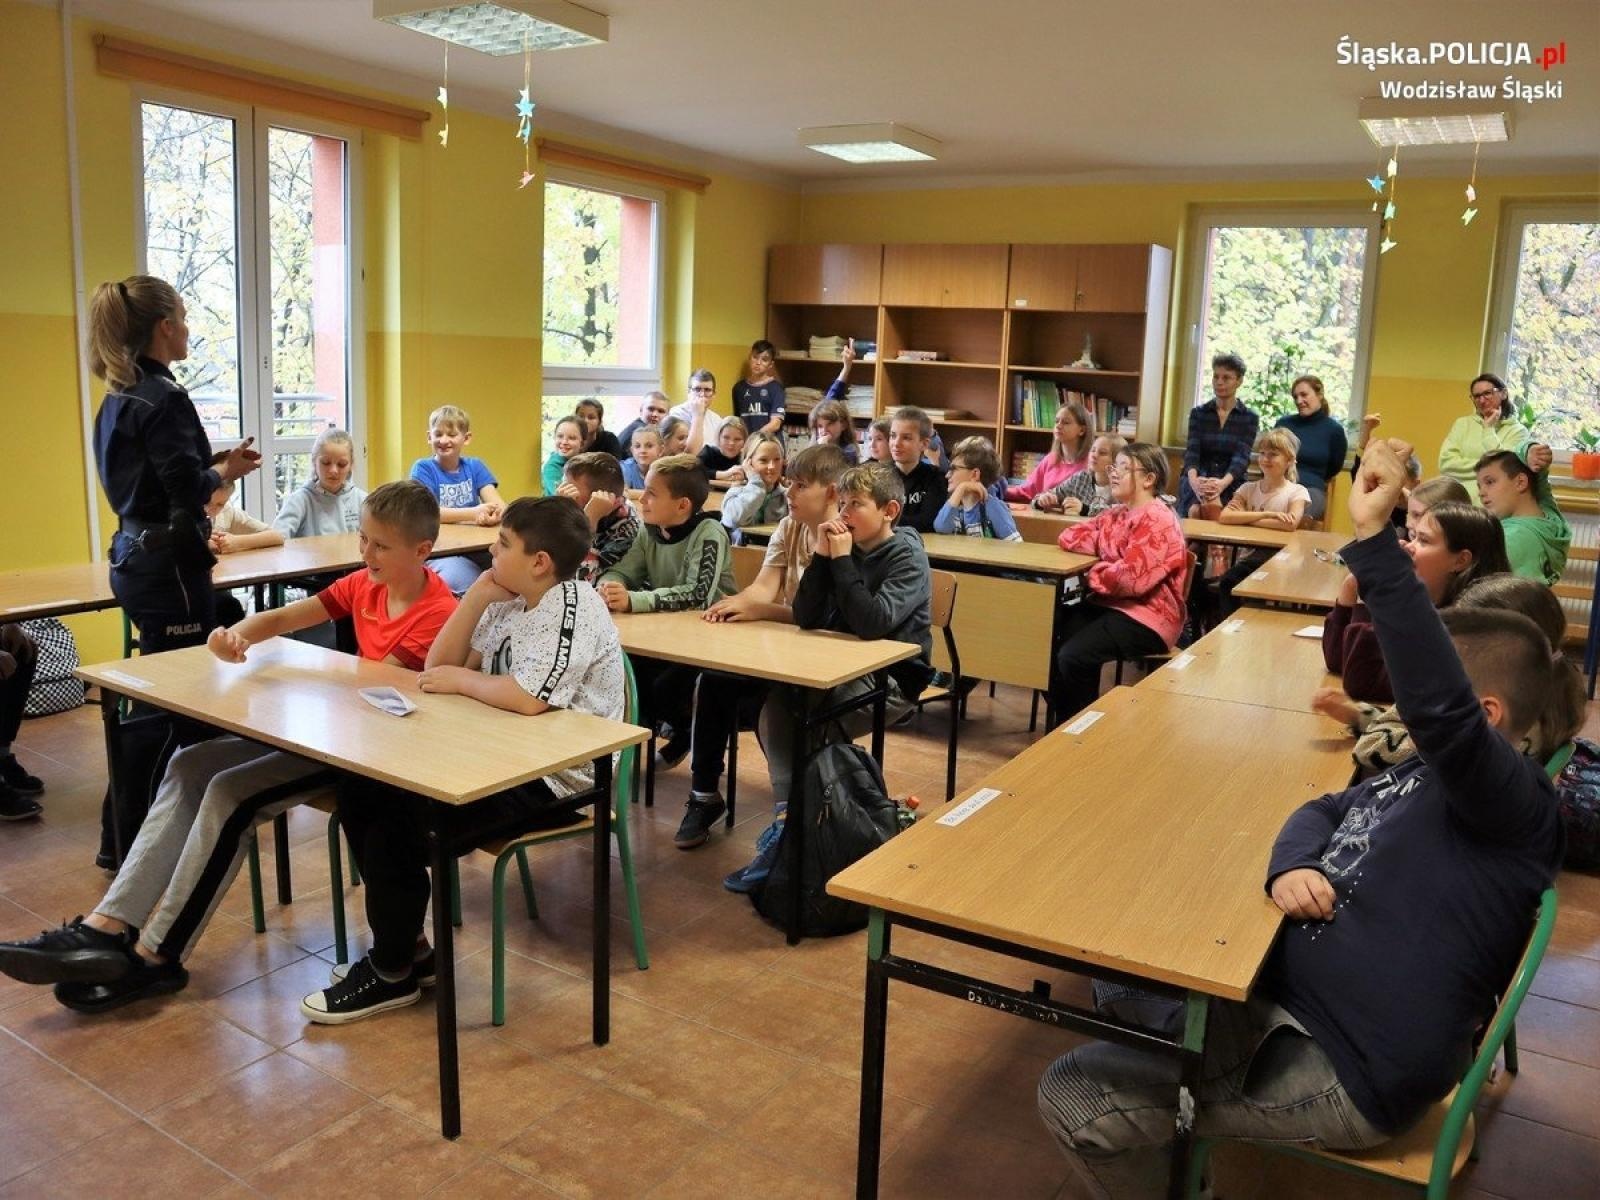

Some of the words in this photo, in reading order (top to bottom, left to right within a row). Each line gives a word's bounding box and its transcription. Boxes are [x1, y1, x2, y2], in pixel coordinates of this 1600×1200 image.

[166, 623, 202, 636] POLICJA
[564, 607, 576, 630] US
[546, 636, 570, 689] AMONG
